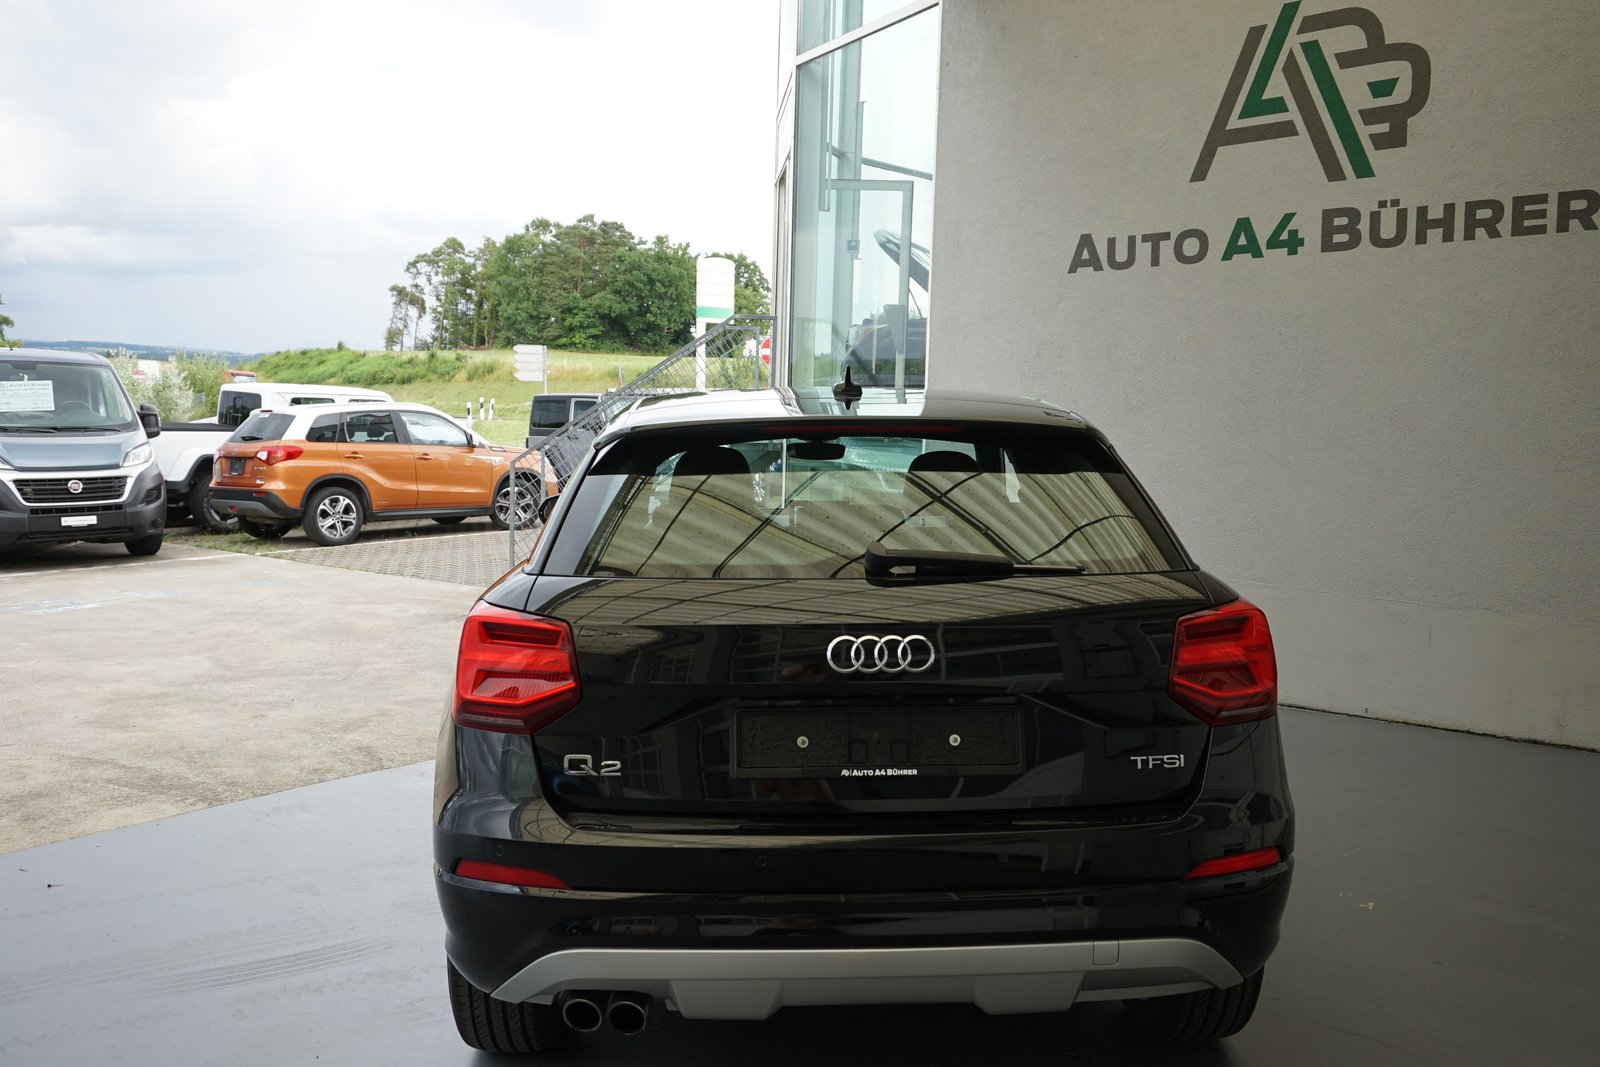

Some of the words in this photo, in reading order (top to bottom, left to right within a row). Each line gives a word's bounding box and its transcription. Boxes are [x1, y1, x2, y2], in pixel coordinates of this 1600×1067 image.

[1067, 228, 1210, 274] AUTO
[1221, 211, 1305, 262] A4
[1320, 189, 1600, 254] BÜHRER
[563, 754, 622, 777] Q2
[1130, 754, 1185, 769] TFSI
[852, 769, 874, 777] AUTO
[874, 769, 886, 777] A4
[886, 768, 918, 776] BÜHRER
